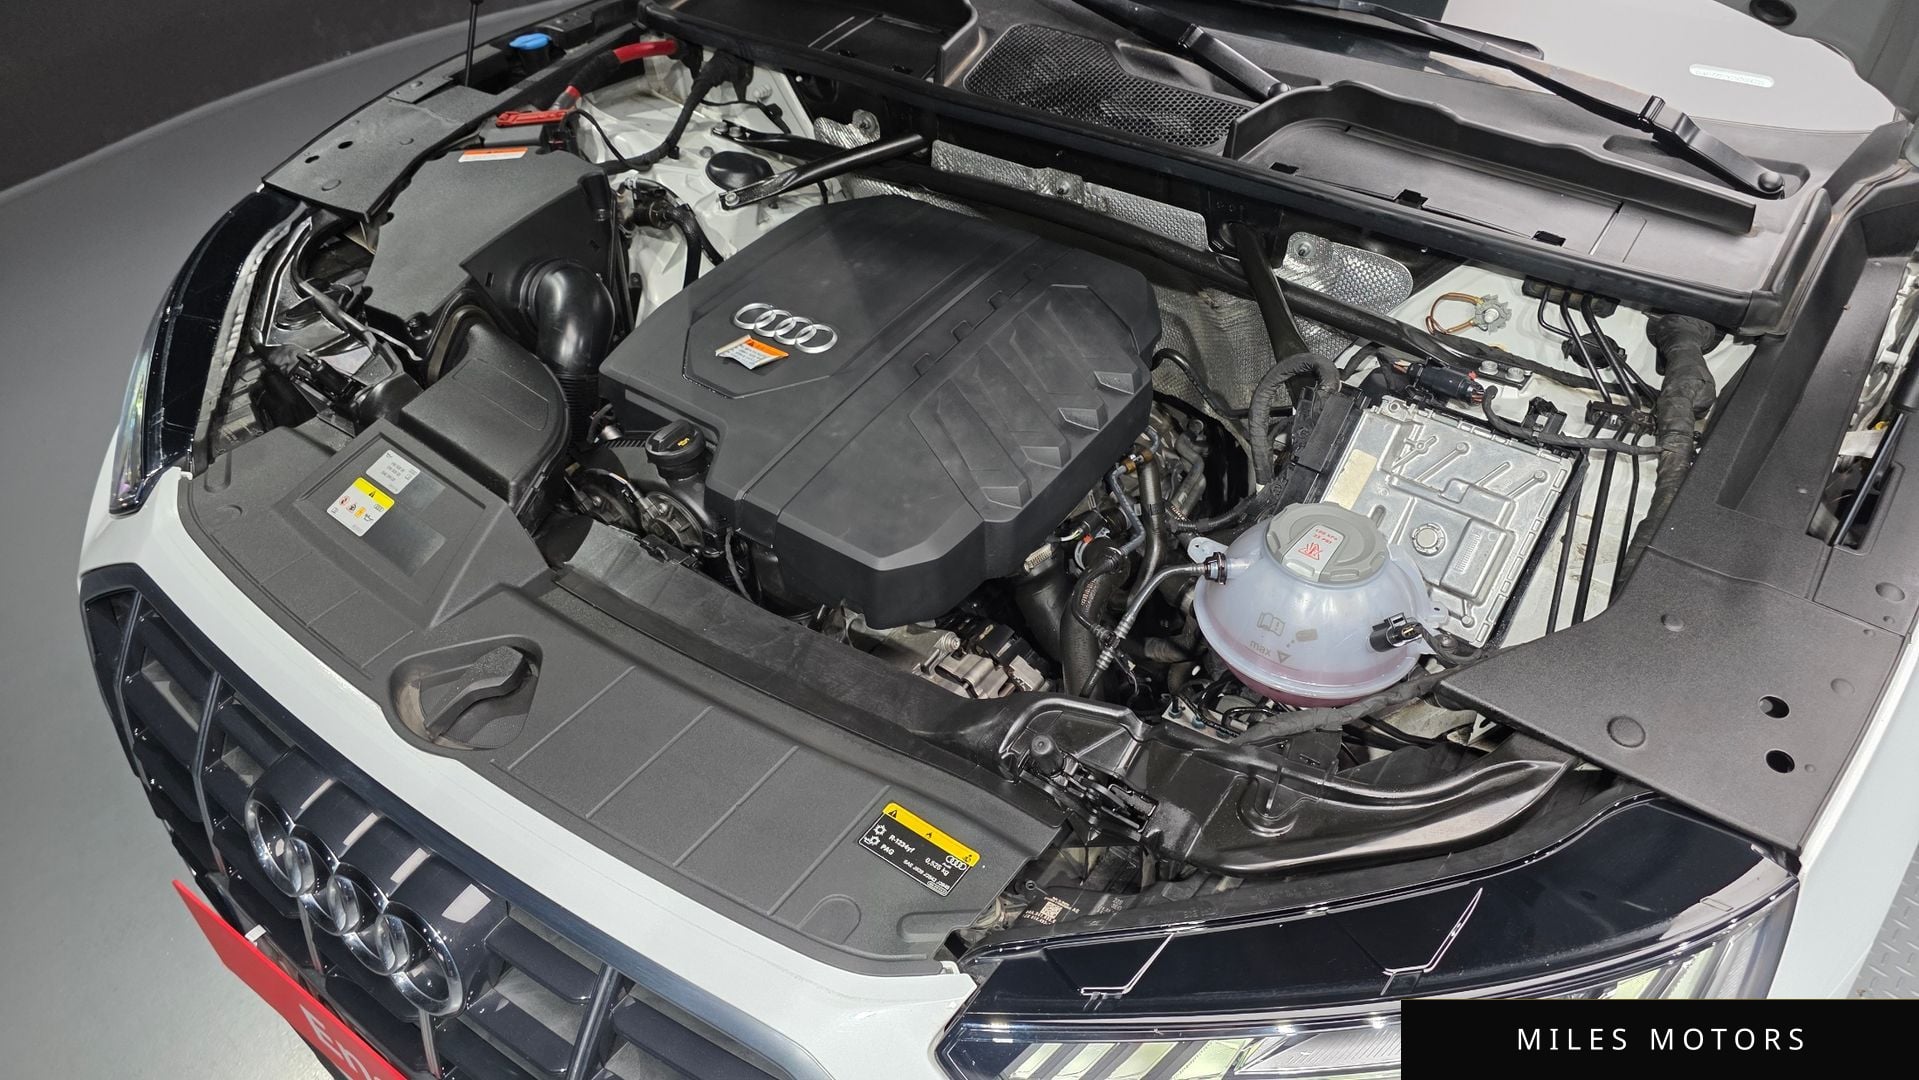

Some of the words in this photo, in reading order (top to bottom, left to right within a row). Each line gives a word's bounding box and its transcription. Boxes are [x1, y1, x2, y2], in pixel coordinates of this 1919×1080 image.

[1250, 640, 1271, 657] max
[880, 843, 895, 856] PAG
[941, 867, 950, 877] kg
[299, 1003, 382, 1080] En
